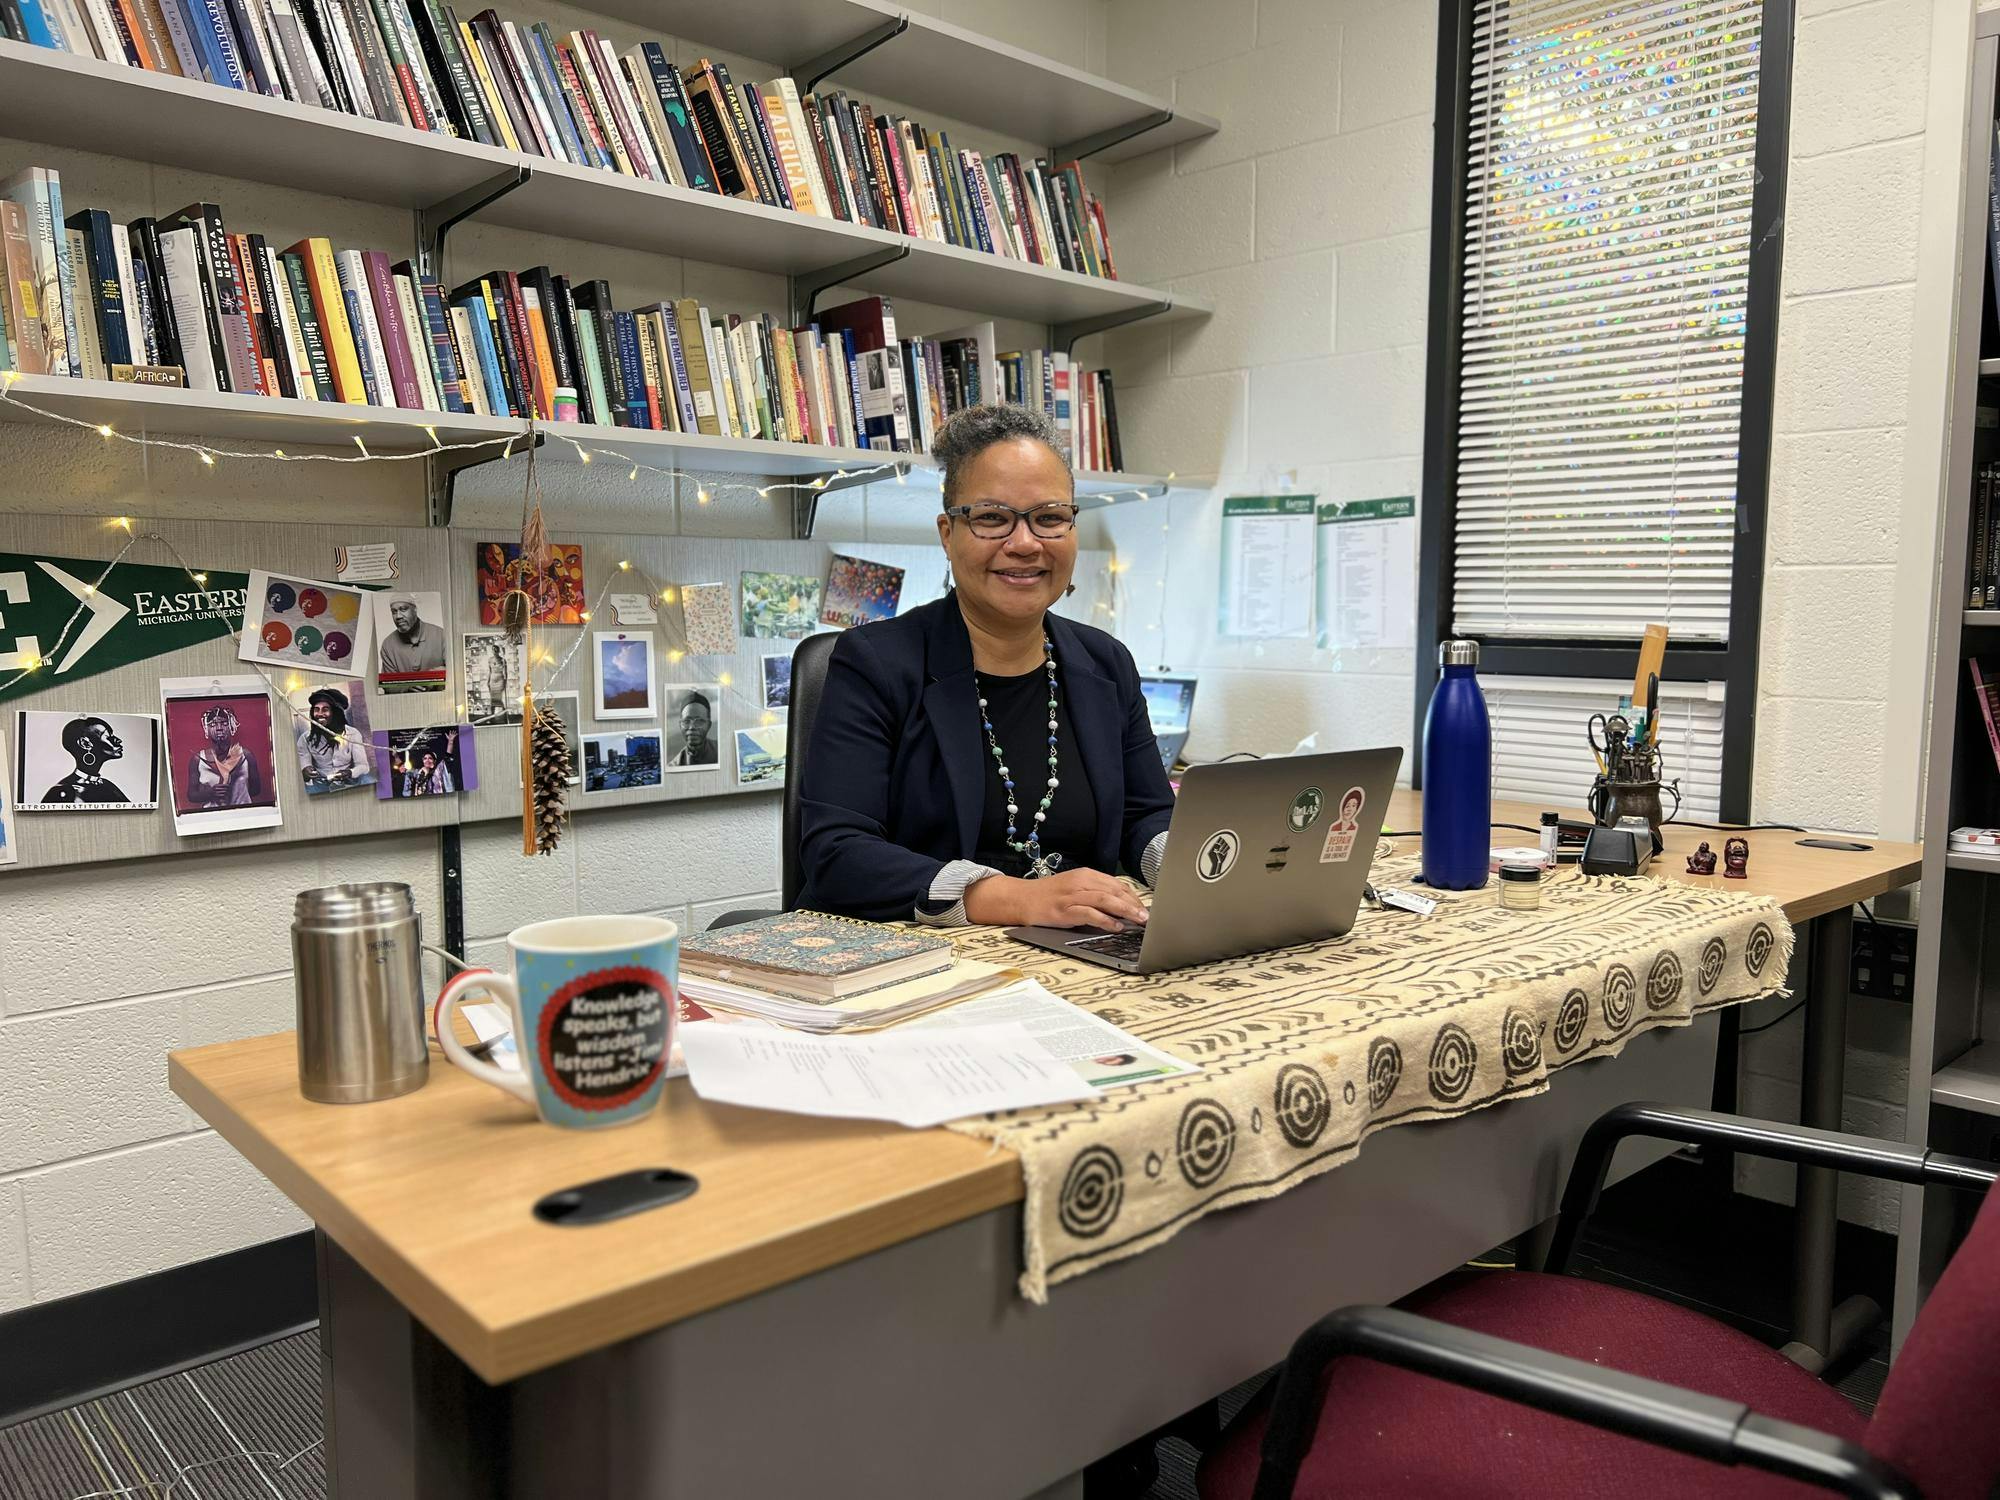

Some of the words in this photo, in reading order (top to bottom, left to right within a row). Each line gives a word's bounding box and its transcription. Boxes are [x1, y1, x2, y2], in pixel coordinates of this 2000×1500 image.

[167, 9, 182, 36] LAND
[355, 7, 363, 18] of
[206, 0, 241, 83] REVOLUTION
[356, 18, 378, 59] Crossing
[152, 38, 167, 69] Emmanuel
[450, 61, 469, 90] Spirit
[463, 90, 475, 103] Of
[468, 103, 486, 127] Haiti
[591, 81, 615, 127] AFRICAN
[608, 127, 625, 155] TALES
[753, 103, 763, 122] ORAL
[810, 111, 825, 142] NISA
[869, 129, 878, 144] AM
[724, 82, 747, 131] STAMPED
[742, 130, 754, 150] FROM
[750, 150, 759, 164] THE
[755, 164, 772, 201] BEGINNING
[759, 123, 775, 158] TRADITION
[766, 109, 808, 189] AFRICA
[771, 158, 778, 168] AS
[846, 123, 860, 158] LITERATURE
[856, 160, 862, 168] OF
[859, 182, 874, 216] CARIBBEAN
[872, 145, 887, 181] BECAUSE
[892, 156, 904, 181] FLASH
[918, 155, 934, 190] Systemic
[773, 167, 787, 196] HISTORY
[882, 182, 891, 200] WE
[898, 181, 906, 192] OF
[972, 156, 991, 207] AFROCUBA
[1001, 179, 1013, 206] HAITI
[34, 201, 44, 226] COULD
[42, 201, 50, 216] THE
[886, 202, 895, 215] ARE
[900, 193, 910, 209] THE
[43, 217, 54, 244] PEOPLE
[904, 209, 916, 234] SPIRIT
[1018, 206, 1033, 247] ACCUSATION
[38, 227, 46, 243] FLY
[214, 217, 231, 278] AFRICAN
[72, 237, 83, 265] MASTER
[209, 231, 223, 278] VODUN
[258, 246, 265, 256] BY
[260, 256, 268, 270] ANY
[240, 237, 253, 274] FRAMING
[247, 275, 259, 308] SILENCE
[262, 270, 272, 292] MEANS
[329, 268, 338, 292] SPIRITS
[139, 279, 153, 326] Webster's
[147, 328, 157, 349] New
[267, 292, 280, 329] NECESSARY
[352, 253, 366, 291] REFUSAL
[367, 314, 380, 352] SHADOW
[444, 309, 449, 317] NO
[504, 298, 516, 325] GENDER
[548, 300, 558, 322] African
[230, 262, 240, 282] LIFE
[235, 285, 243, 296] IN
[239, 309, 254, 349] HAITIAN
[247, 351, 261, 385] VALLEY
[280, 279, 292, 305] CULTURE
[289, 313, 303, 354] IMPERIALISM
[510, 325, 517, 333] IN
[617, 314, 625, 326] OF
[639, 317, 649, 341] THINGS
[663, 306, 676, 335] AFRICA
[304, 320, 320, 349] Spirit
[446, 318, 456, 345] TELEPHONE
[516, 303, 528, 335] HAITIAN
[523, 336, 534, 364] VODOU
[553, 323, 564, 353] American
[619, 327, 627, 343] THE
[623, 322, 637, 355] PEOPLE'S
[311, 350, 323, 361] Of
[512, 333, 523, 361] AFRICAN
[620, 344, 631, 373] UNITED
[642, 342, 650, 358] FALL
[133, 370, 169, 382] AFRICA
[314, 361, 331, 385] Haiti
[454, 354, 463, 375] HEAVEN
[518, 360, 530, 390] WOMEN'S
[557, 352, 569, 379] Politics
[612, 356, 622, 378] BRIGHT
[629, 355, 642, 389] HISTORY
[644, 359, 654, 380] APART
[669, 336, 688, 392] REMEMBERED
[849, 360, 860, 393] UNTIMELY
[266, 365, 276, 391] CHANCY
[616, 378, 625, 400] NIGHTS
[624, 375, 635, 400] STATES
[684, 402, 693, 422] Curtin
[852, 393, 866, 435] MEDITATIONS
[1972, 586, 1980, 594] 2
[1987, 585, 1995, 593] 2
[137, 614, 193, 626] MICHIGAN
[196, 608, 246, 620] UNIVERSI
[1328, 835, 1352, 845] DESPAIR
[571, 991, 658, 1014] Knowledge
[562, 1015, 632, 1035] speaks,
[636, 1009, 661, 1027] but
[553, 1053, 614, 1070] listens
[628, 1039, 662, 1063] Jimi
[576, 1031, 646, 1052] wisdom
[574, 1063, 650, 1089] Hendrix
